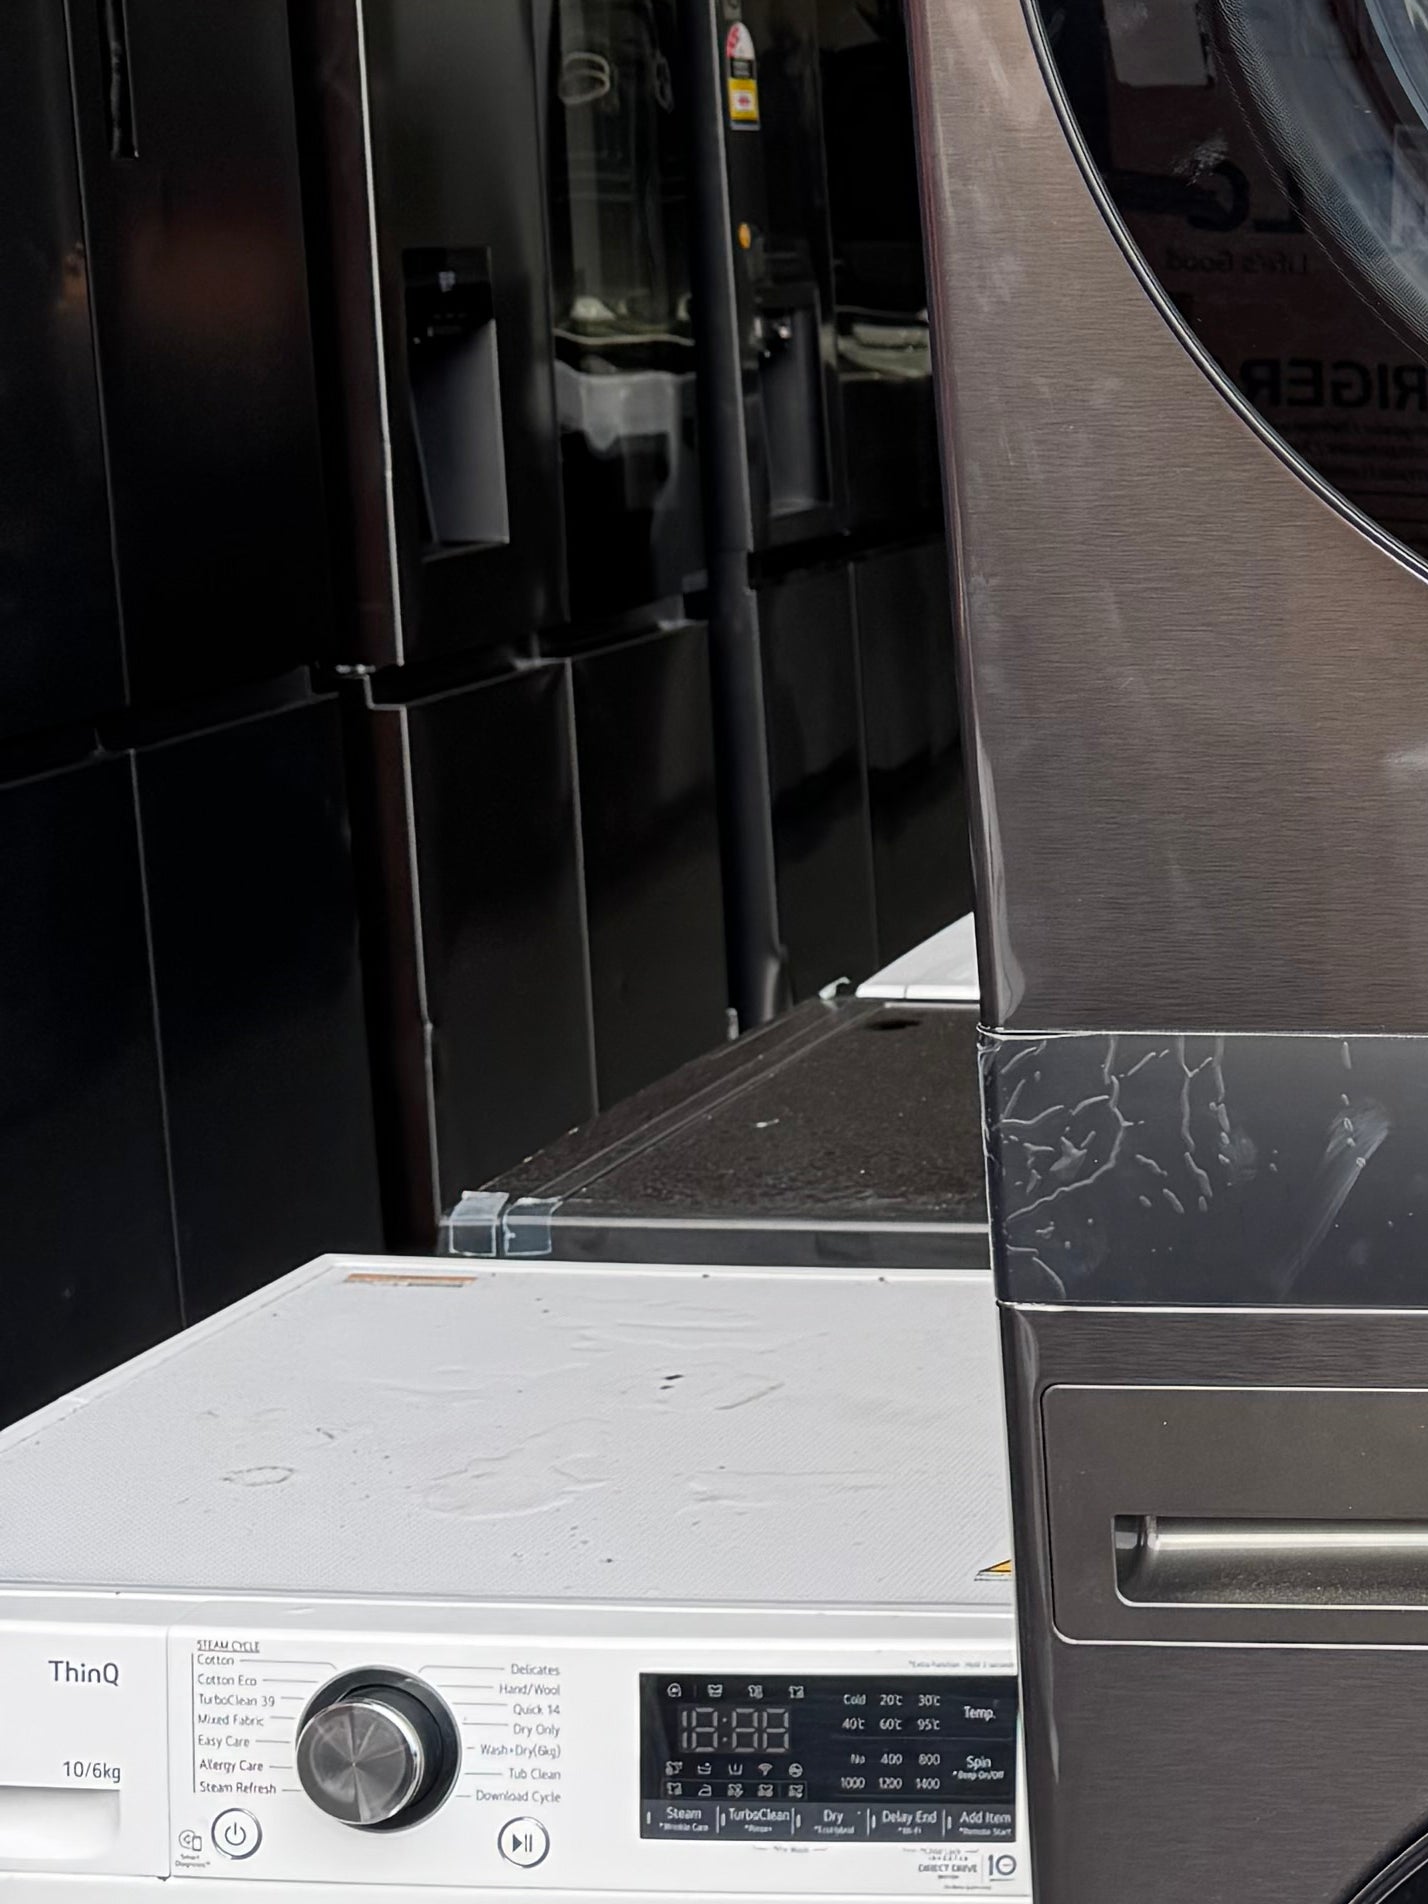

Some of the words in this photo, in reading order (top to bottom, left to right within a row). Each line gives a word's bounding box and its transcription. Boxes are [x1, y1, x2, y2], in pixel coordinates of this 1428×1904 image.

[197, 1654, 234, 1665] Cotton
[48, 1660, 119, 1686] ThinQ
[511, 1664, 560, 1675] Delicates
[197, 1674, 234, 1686] Cotton
[238, 1675, 257, 1686] Eco
[500, 1684, 560, 1696] Hand/Wool
[199, 1694, 257, 1706] TurboClean
[262, 1696, 275, 1707] 39
[513, 1703, 543, 1716] Quick
[964, 1706, 996, 1721] Temp.
[198, 1714, 229, 1725] Mixed
[233, 1715, 263, 1726] Fabric
[513, 1723, 532, 1738] Dry
[536, 1724, 560, 1738] Only
[198, 1735, 222, 1749] Easy
[226, 1736, 250, 1747] Care
[881, 1754, 902, 1764] 400
[966, 1755, 991, 1770] Spin
[63, 1761, 120, 1783] 10/6kg
[200, 1759, 236, 1773] Allergy
[240, 1760, 263, 1771] Care
[509, 1768, 527, 1779] Tub
[531, 1768, 561, 1780] Clean
[200, 1781, 232, 1793] Steam
[236, 1782, 276, 1794] Refresh
[841, 1777, 865, 1789] 1000
[879, 1777, 902, 1789] 1200
[916, 1778, 940, 1789] 1400
[476, 1789, 529, 1802] Download
[532, 1791, 561, 1804] Cycle
[666, 1806, 701, 1820] Steam
[729, 1808, 790, 1822] TurboClean
[823, 1809, 844, 1824] Dry
[882, 1810, 912, 1825] Delay
[915, 1811, 937, 1824] End
[960, 1811, 983, 1824] Add
[986, 1811, 1011, 1824] Item
